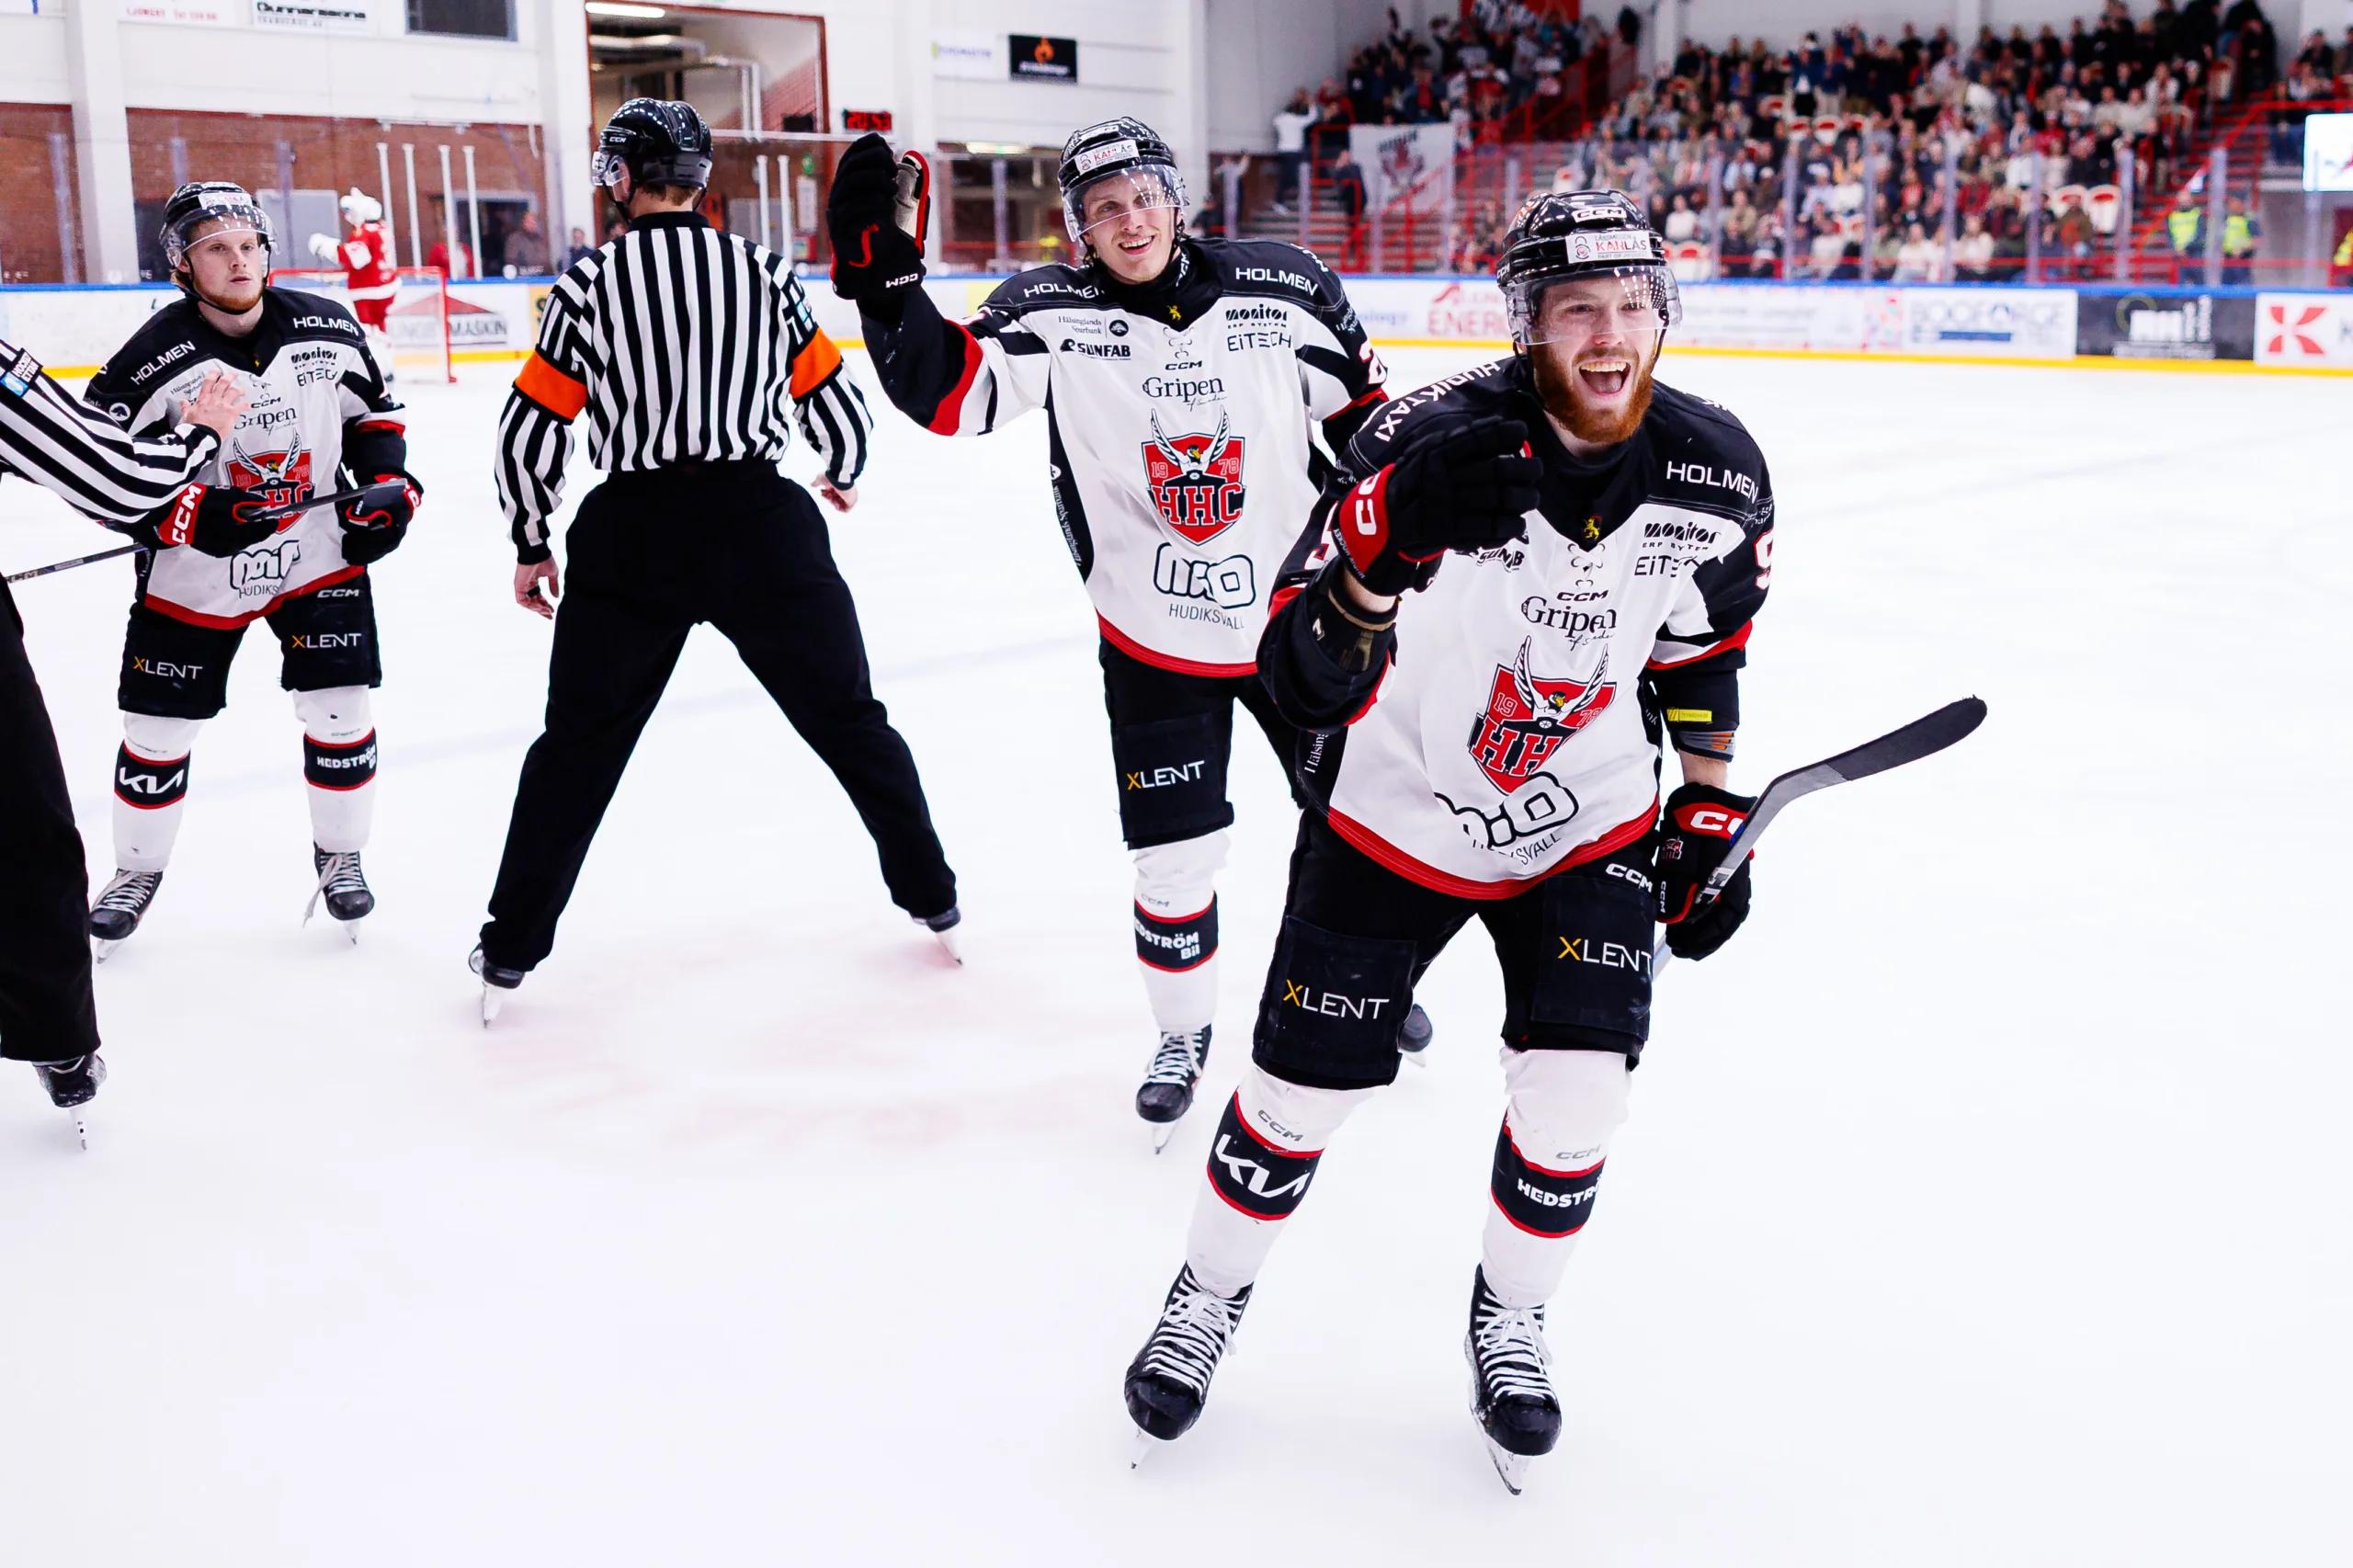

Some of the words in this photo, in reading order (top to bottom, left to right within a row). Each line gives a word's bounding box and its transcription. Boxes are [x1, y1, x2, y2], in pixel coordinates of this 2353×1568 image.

[1577, 209, 1622, 219] CCM
[885, 273, 918, 289] CCM
[1235, 267, 1319, 296] HOLMEN
[1225, 303, 1288, 321] monitor
[293, 316, 359, 336] HOLMEN
[131, 340, 197, 385] HOLMEN
[1078, 343, 1131, 358] SUNFAB
[1165, 360, 1202, 370] CCM
[250, 396, 281, 409] CCM
[1142, 377, 1224, 403] Gripen
[1151, 461, 1168, 479] 19
[1218, 458, 1240, 476] 78
[1666, 460, 1759, 505] HOLMEN
[171, 483, 202, 544] CCM
[1150, 482, 1244, 526] HHC
[1355, 472, 1381, 536] CC
[1643, 521, 1722, 544] monitor
[317, 588, 359, 598] CCM
[1556, 589, 1609, 602] CCM
[1168, 604, 1244, 630] HUDIKSVALL
[1520, 596, 1617, 639] Gripen
[291, 632, 363, 648] XLENT
[133, 655, 203, 680] XLENT
[1493, 692, 1518, 718] 19
[1471, 715, 1563, 778] HH
[1127, 759, 1205, 790] XLENT
[1606, 863, 1654, 892] CCM
[1141, 893, 1169, 908] CCM
[1134, 915, 1199, 949] EDSTRÖM
[1180, 944, 1200, 960] Bil
[1558, 936, 1653, 974] XLENT
[1283, 979, 1390, 1020] XLENT
[1257, 1108, 1304, 1142] CCM
[1555, 1143, 1601, 1160] CCM
[1517, 1175, 1602, 1208] HEDSTR
